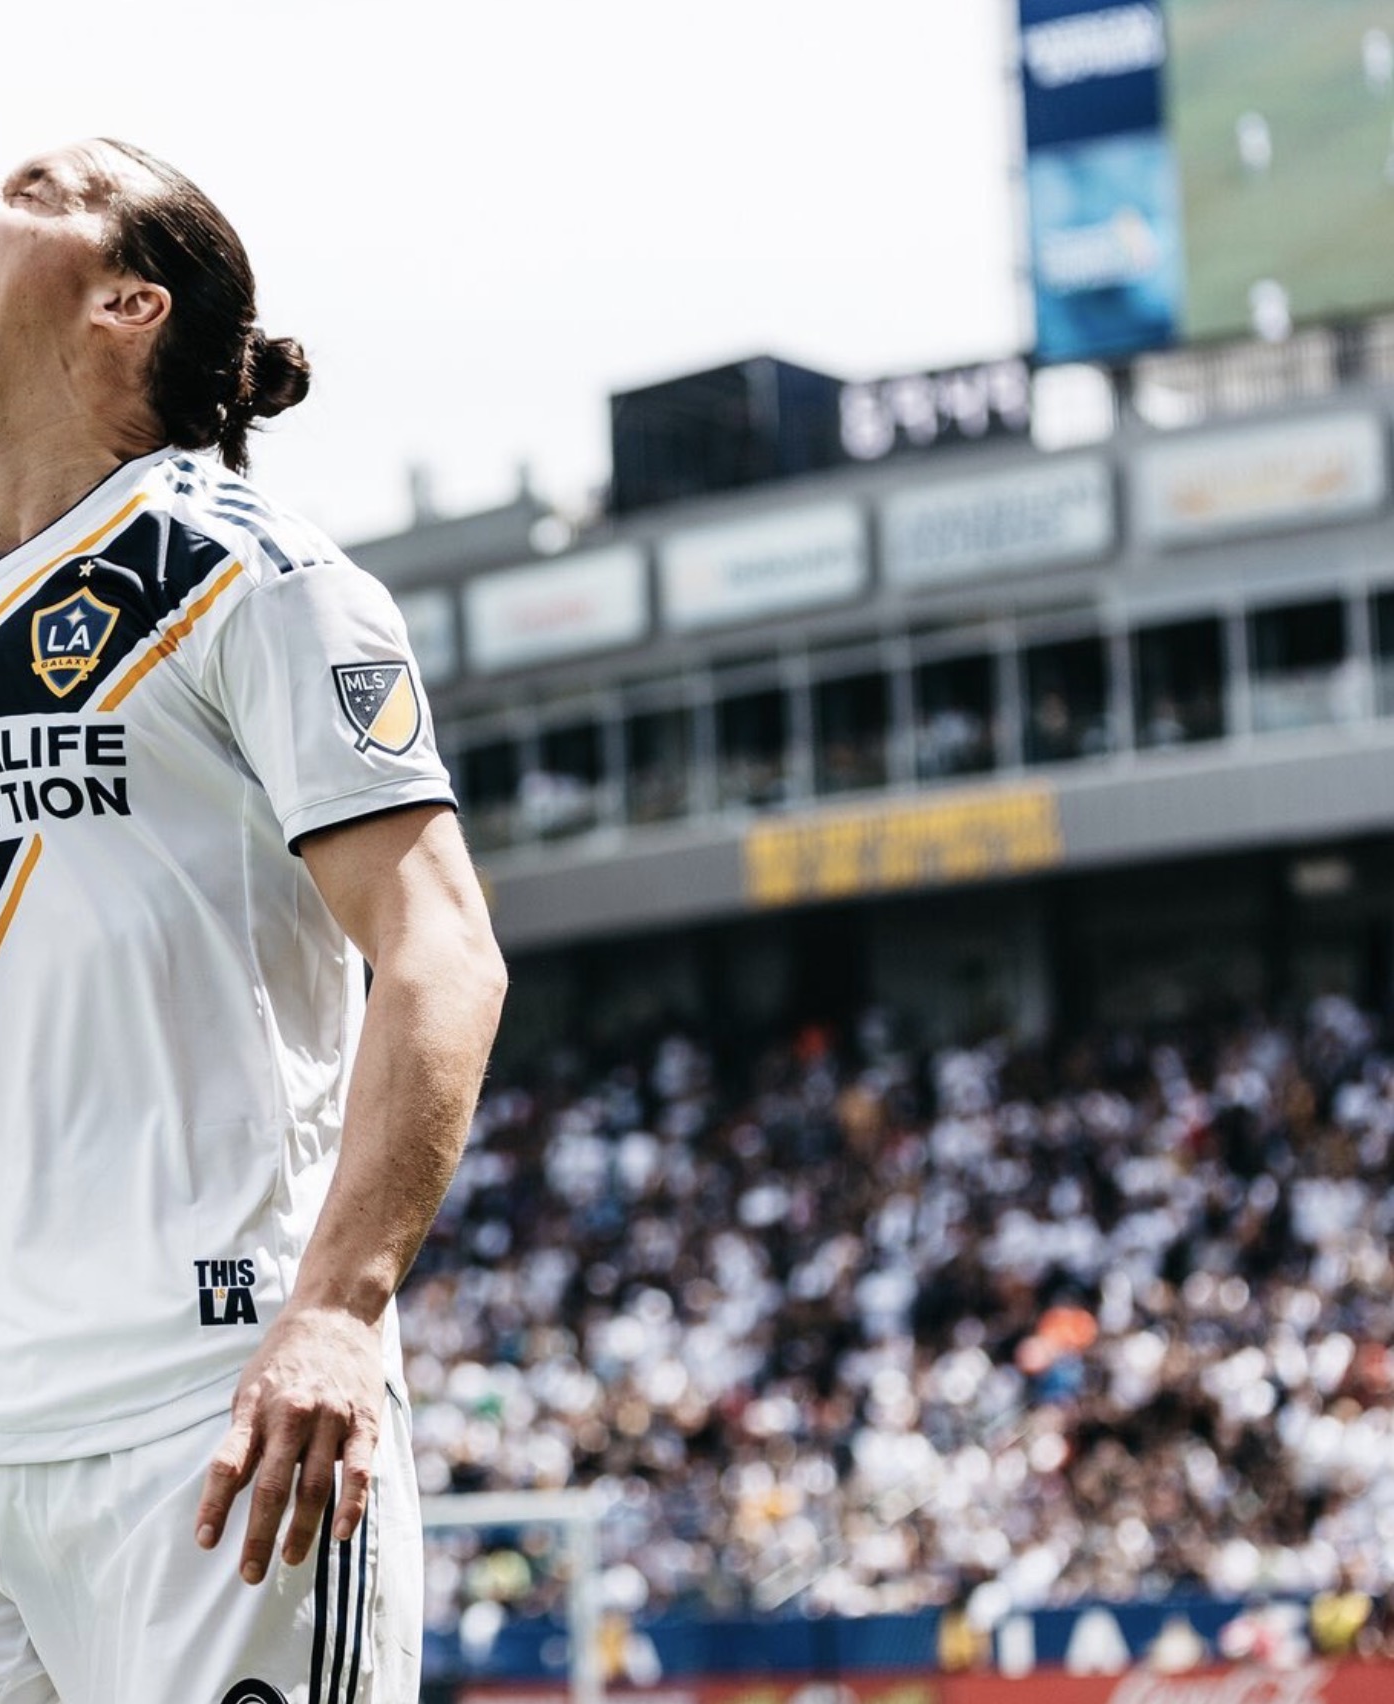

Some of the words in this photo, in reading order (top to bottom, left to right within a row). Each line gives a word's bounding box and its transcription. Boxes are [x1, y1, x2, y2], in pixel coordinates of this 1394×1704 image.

[47, 624, 91, 652] LA
[41, 659, 90, 669] GALAXY
[344, 671, 386, 692] MLS
[193, 1258, 256, 1287] THIS
[199, 1287, 259, 1326] LA
